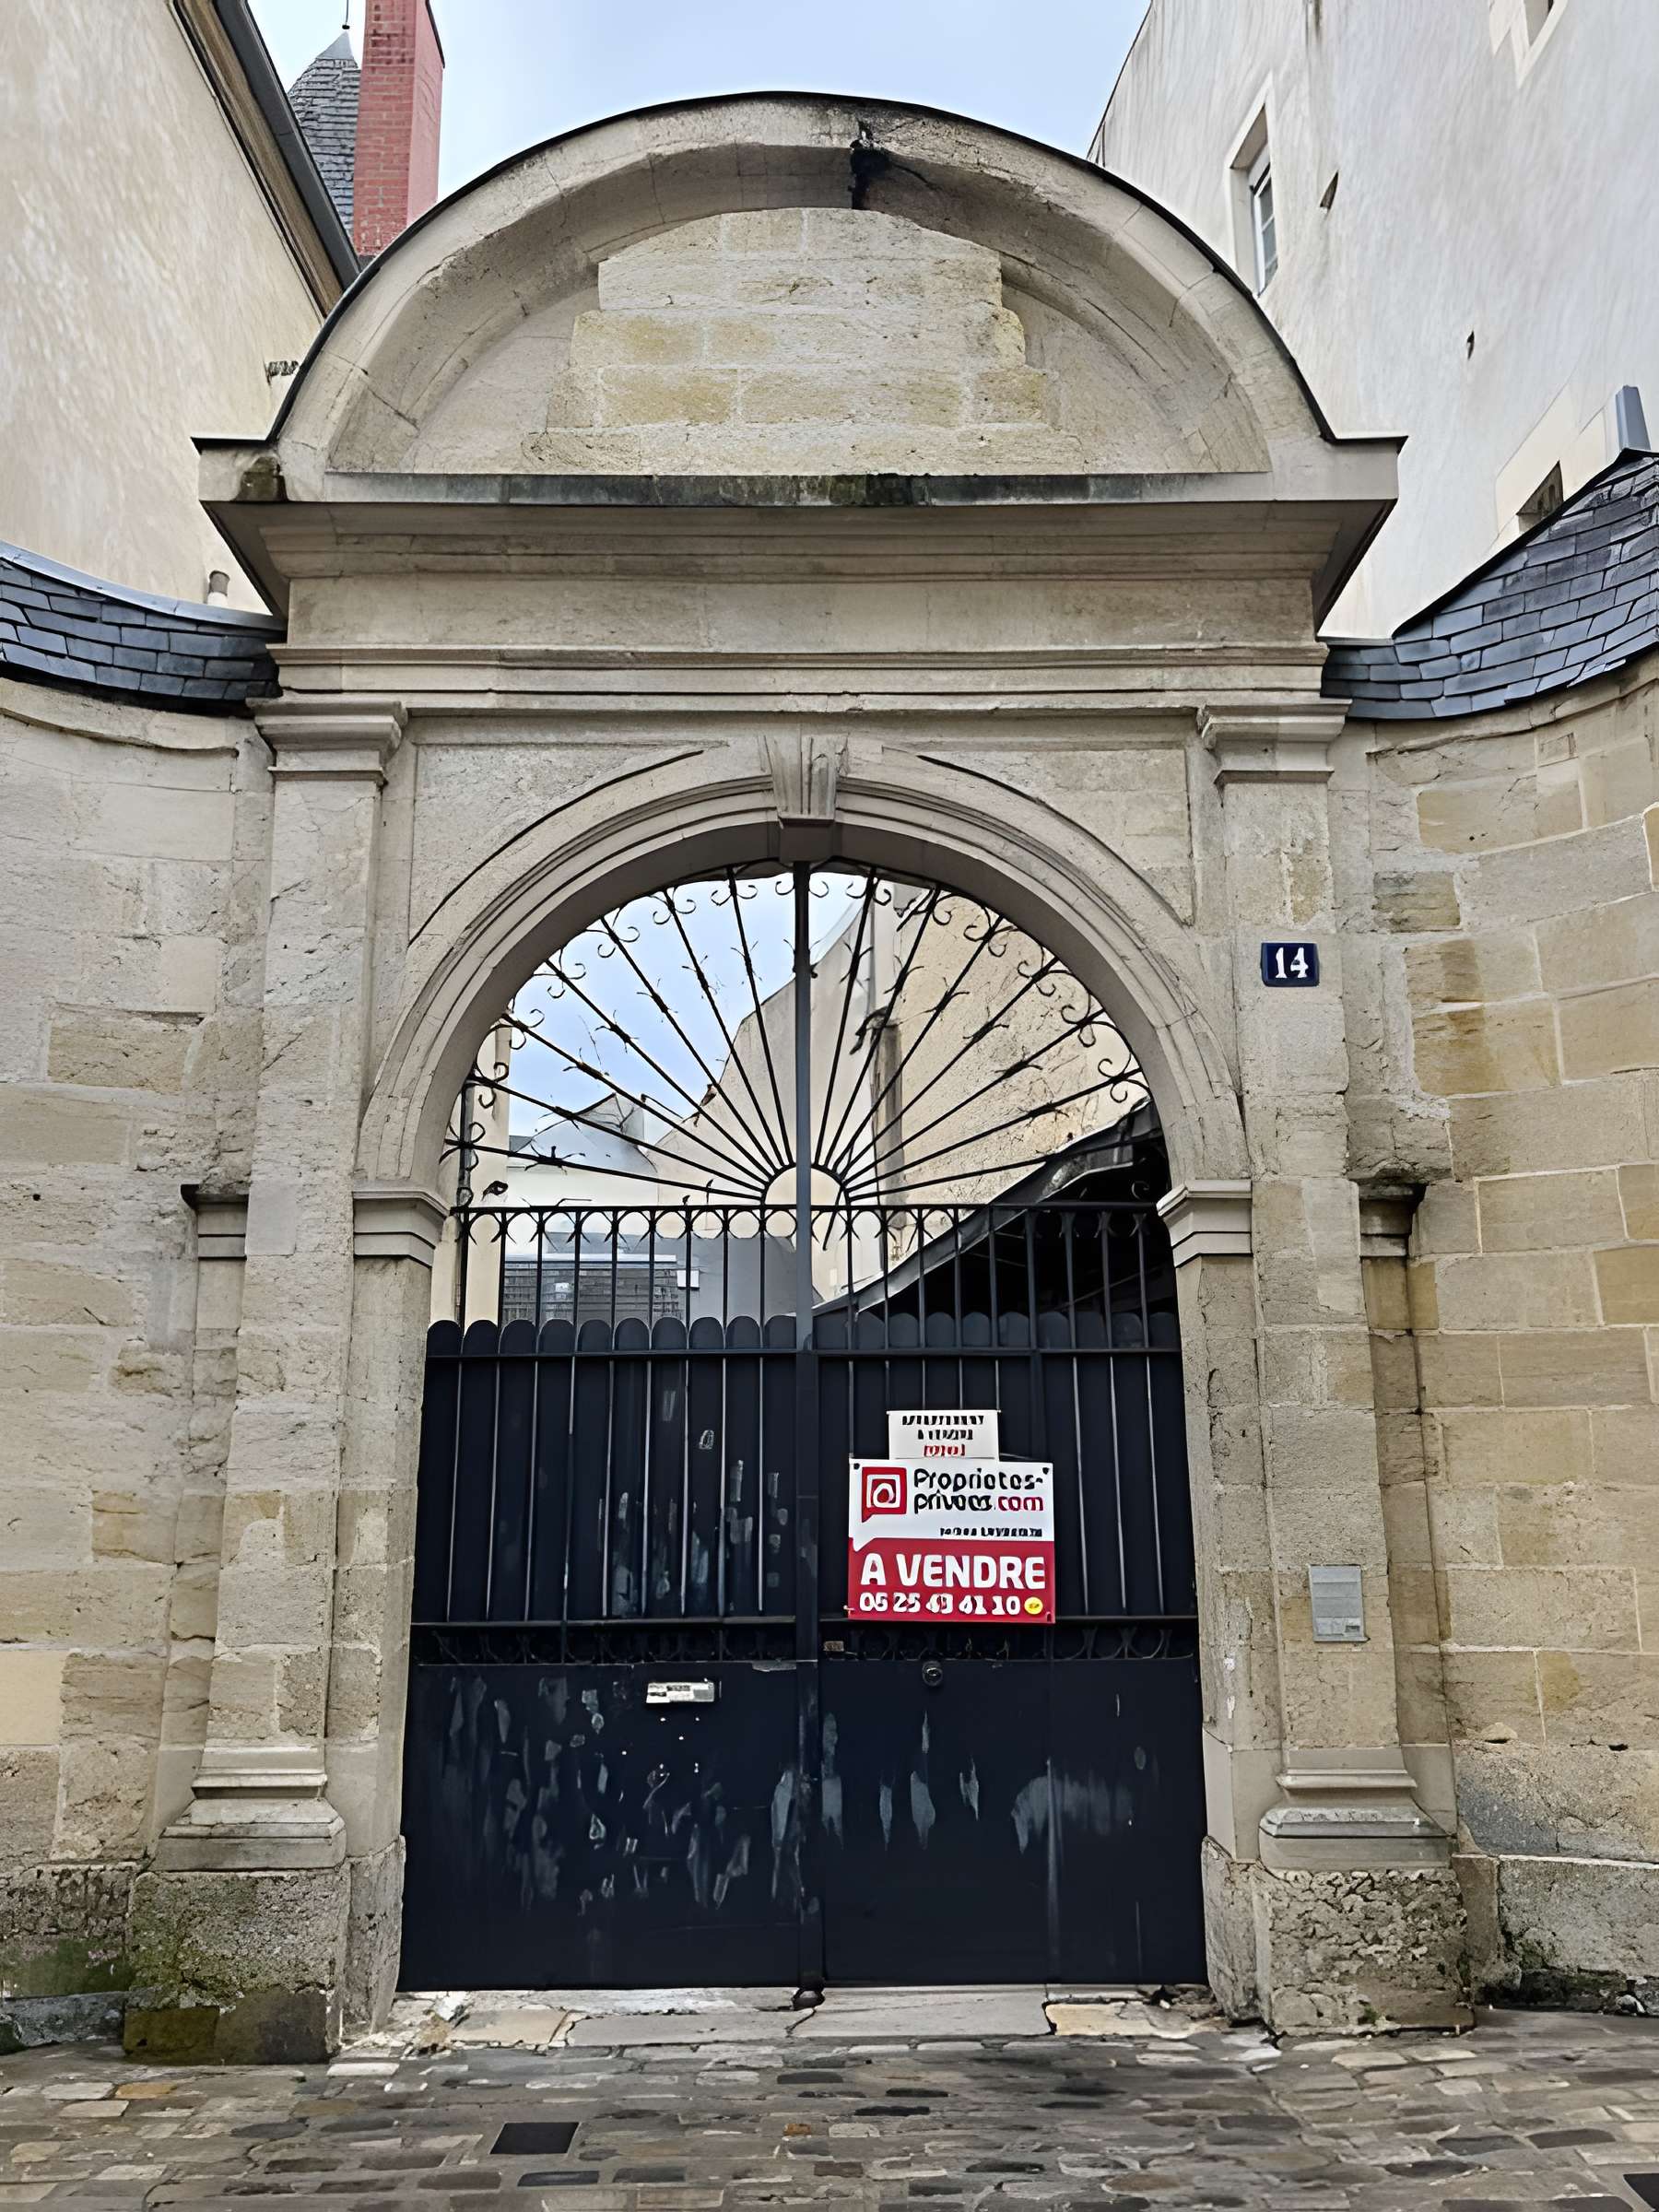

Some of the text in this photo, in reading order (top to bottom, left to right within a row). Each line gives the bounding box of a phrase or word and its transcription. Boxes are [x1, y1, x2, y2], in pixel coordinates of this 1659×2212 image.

[1275, 947, 1309, 979] 14
[860, 1552, 1046, 1590] A VENDRE
[992, 1595, 1021, 1616] 10
